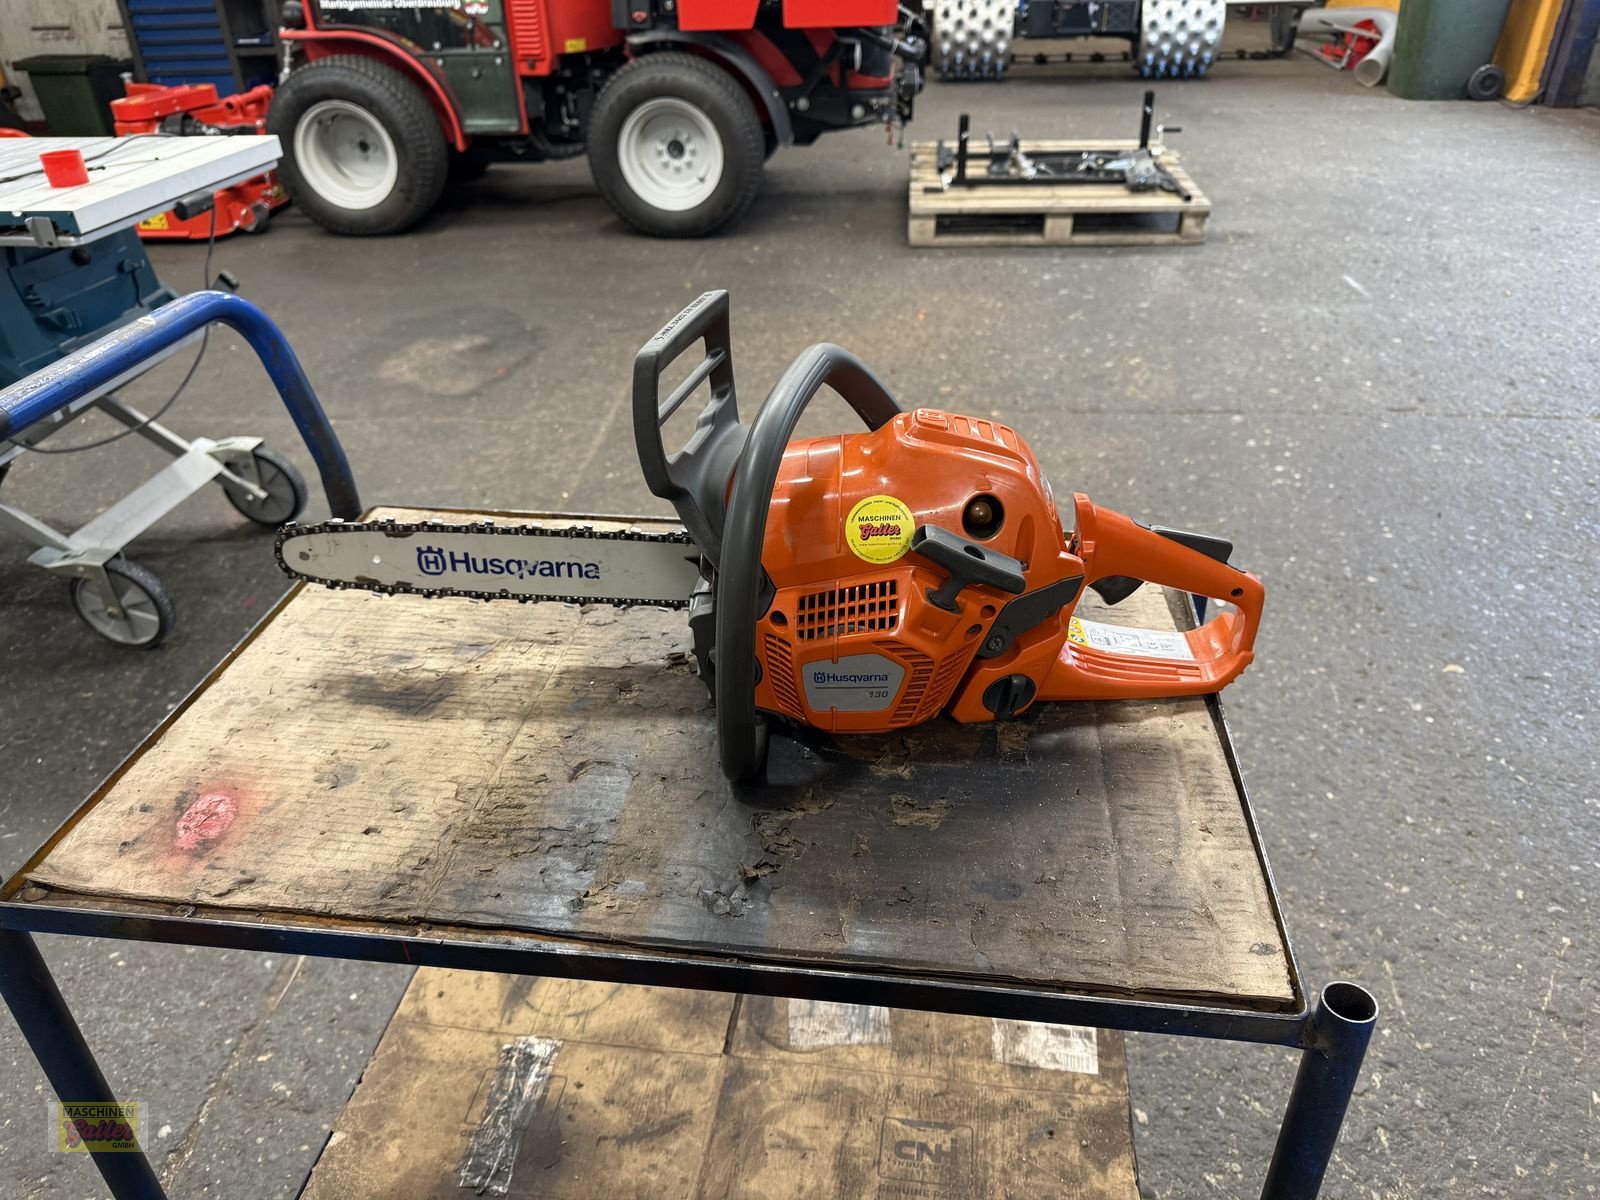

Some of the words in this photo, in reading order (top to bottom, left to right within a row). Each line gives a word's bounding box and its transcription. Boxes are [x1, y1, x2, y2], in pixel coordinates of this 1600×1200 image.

[859, 523, 901, 540] Gailer
[449, 551, 601, 580] Husqvarna
[827, 671, 888, 683] Husqvarna
[868, 690, 888, 698] 130
